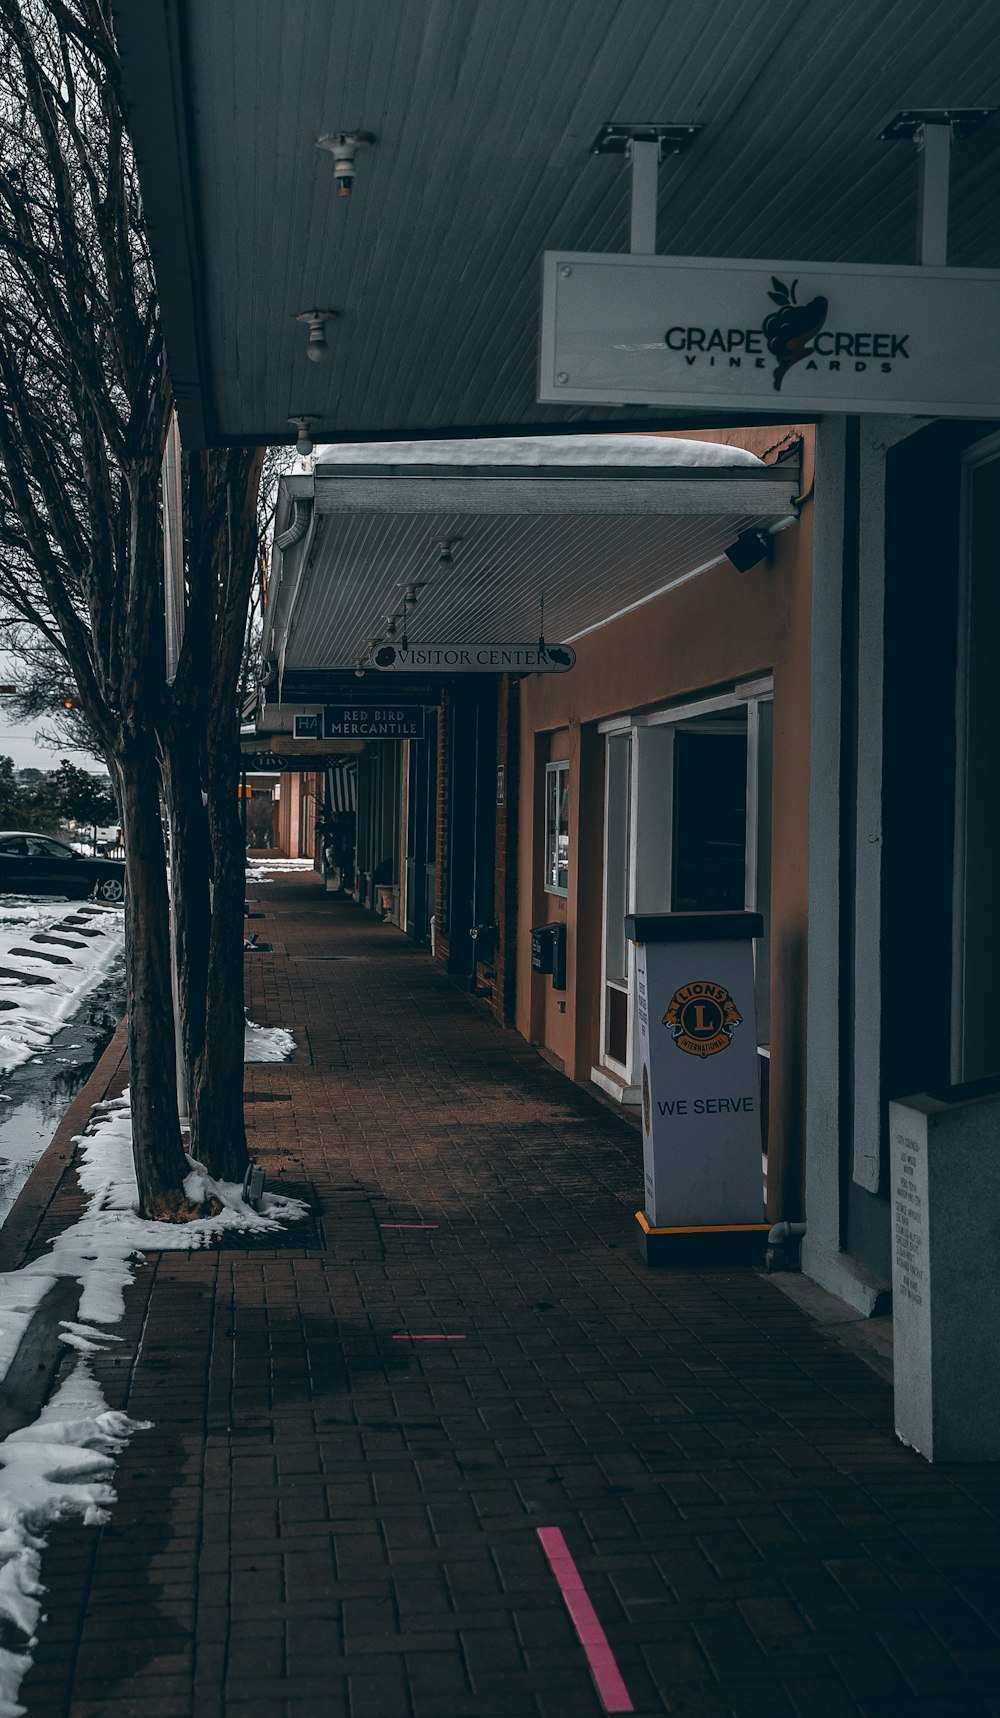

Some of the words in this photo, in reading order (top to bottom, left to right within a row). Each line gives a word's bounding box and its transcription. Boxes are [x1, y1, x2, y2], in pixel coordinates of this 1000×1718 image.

[665, 326, 762, 354] GRAPE
[813, 331, 910, 359] CREEK
[398, 650, 472, 666] VISITOR
[477, 650, 549, 666] CENTER
[343, 710, 368, 721] RED
[374, 710, 405, 721] BIRD
[331, 723, 417, 735] MERCANTILE
[679, 984, 725, 1001] LIONS
[693, 1005, 715, 1031] L
[681, 1037, 726, 1053] INTERNATIONAL
[657, 1100, 688, 1116] WE
[693, 1097, 754, 1115] SERVE
